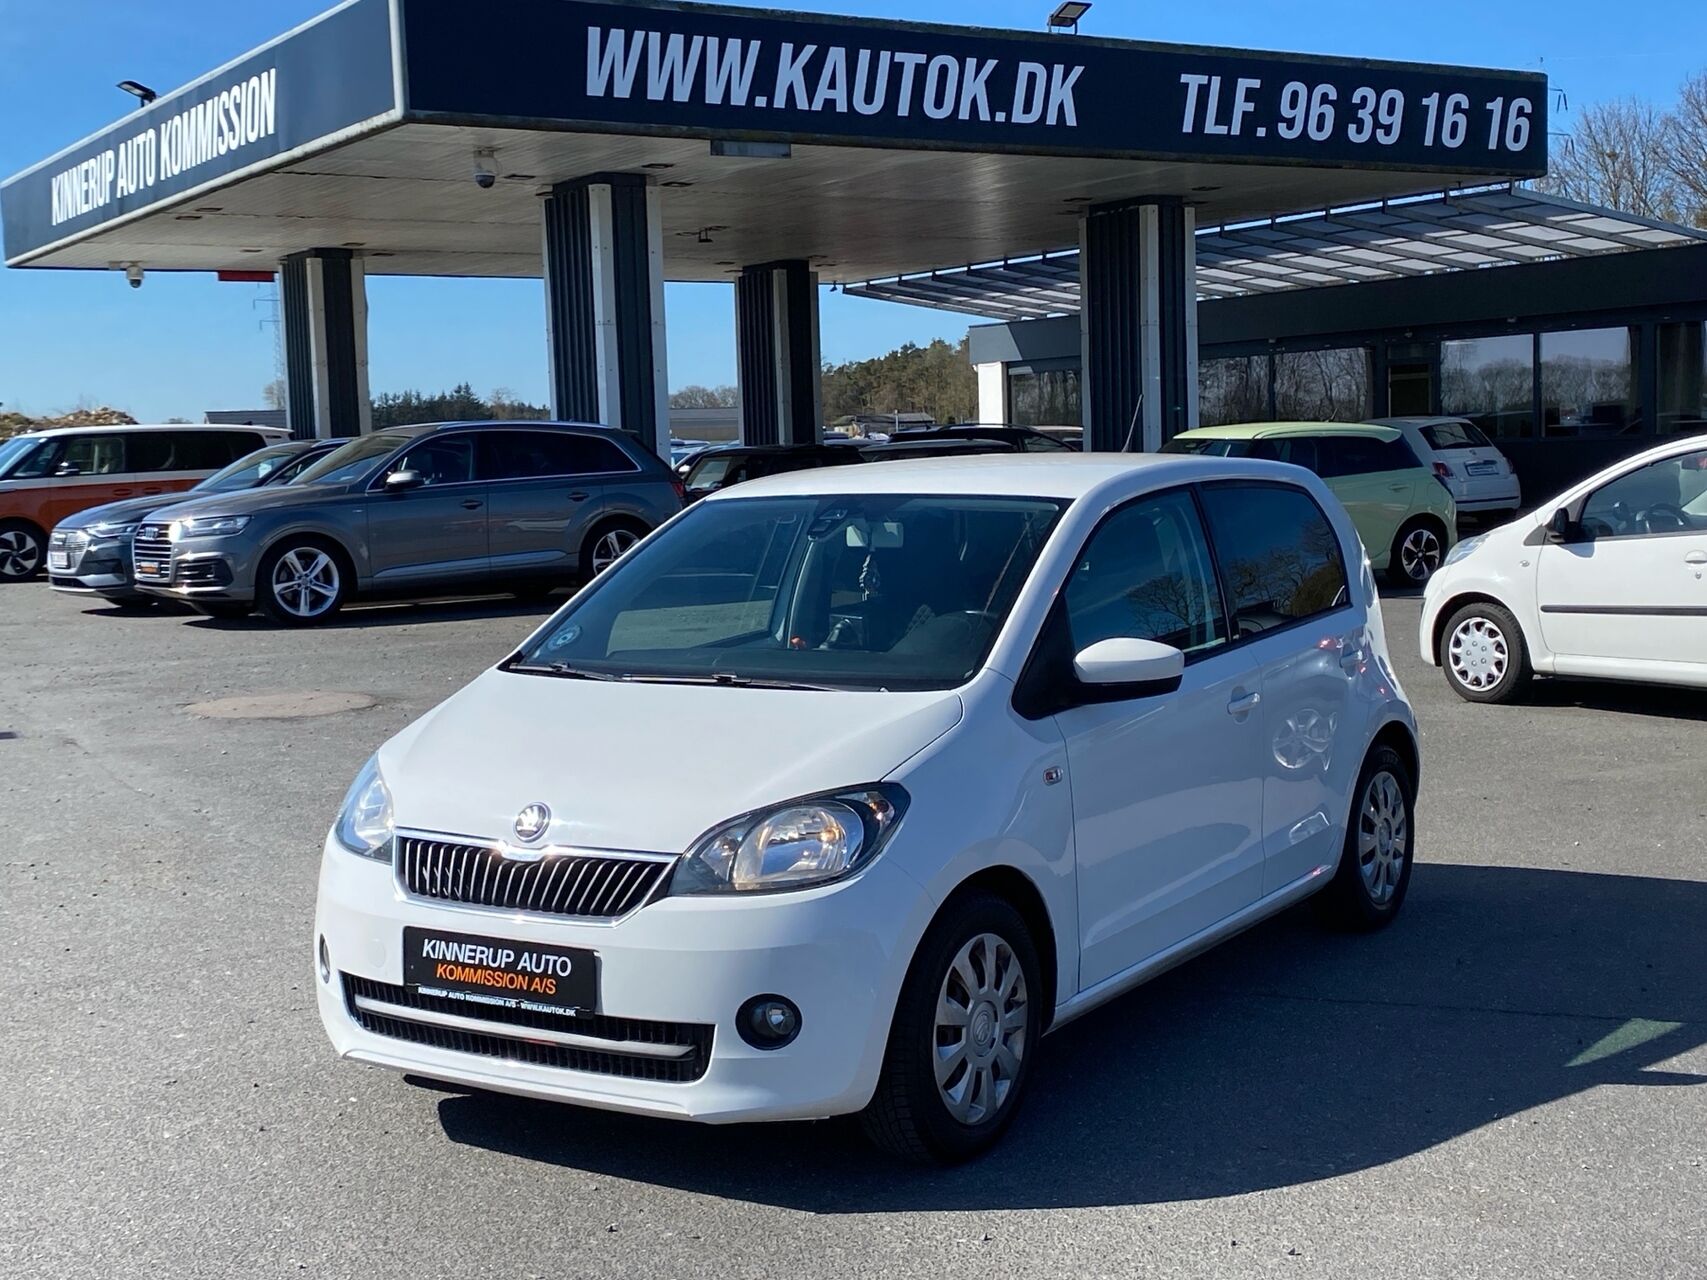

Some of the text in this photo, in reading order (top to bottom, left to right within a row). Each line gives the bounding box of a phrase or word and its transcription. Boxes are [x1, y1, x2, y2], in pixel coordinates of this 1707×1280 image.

[587, 26, 1085, 127] WWW.KAUTOK.DK
[1180, 74, 1532, 151] TLF. 96 39 16 16
[52, 68, 276, 226] KINNERUP AUTO KOMMISSION
[422, 939, 572, 977] KINNERUP AUTO
[436, 964, 556, 995] KOMMISSION A/S
[448, 991, 465, 1001] AUTO
